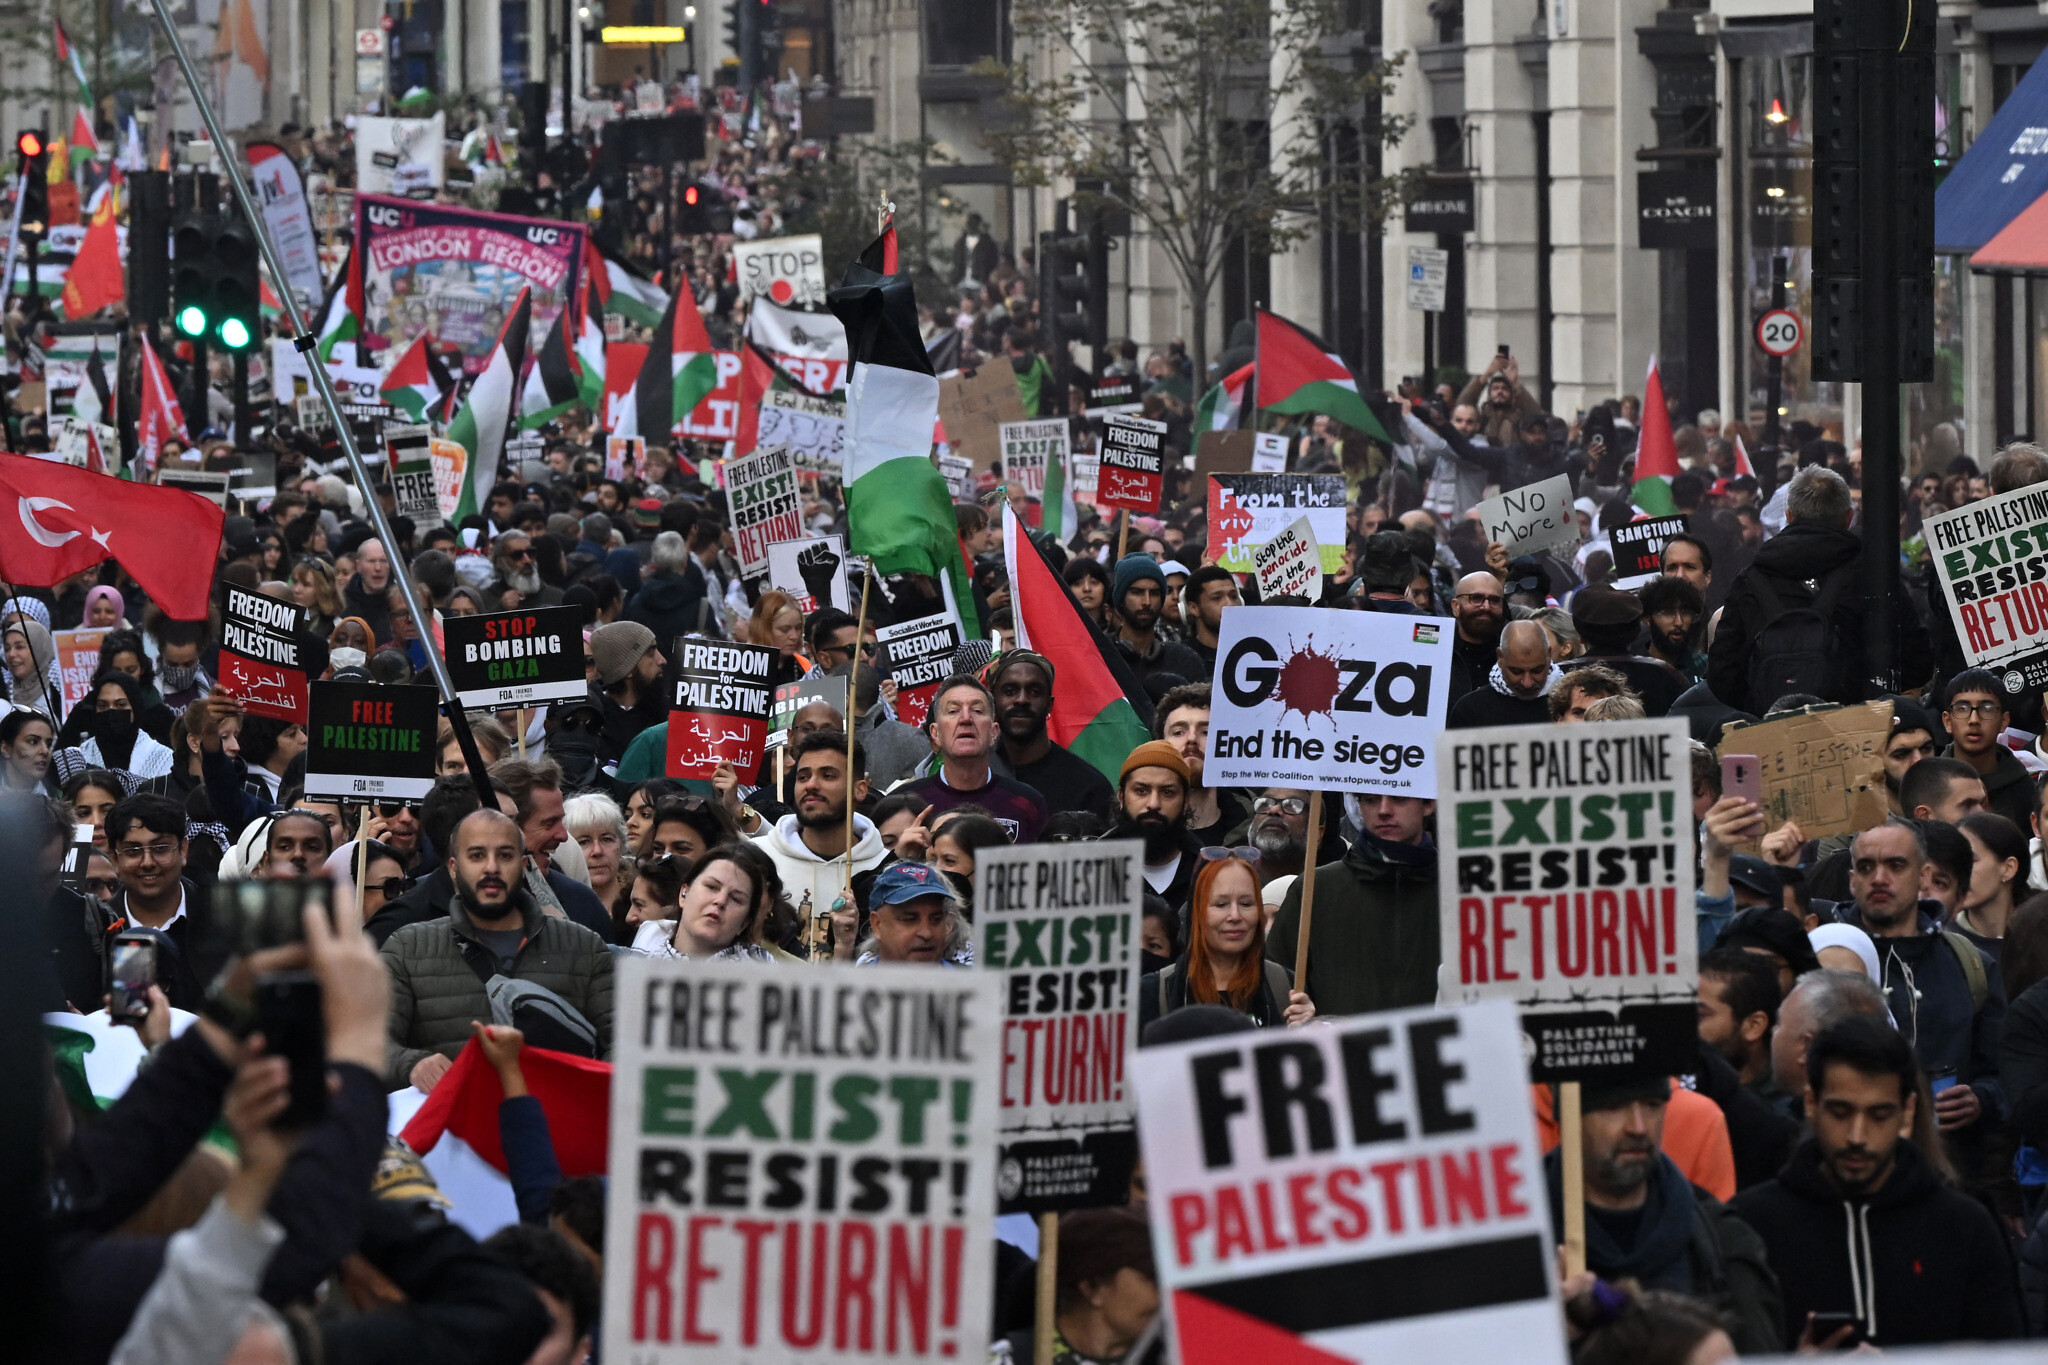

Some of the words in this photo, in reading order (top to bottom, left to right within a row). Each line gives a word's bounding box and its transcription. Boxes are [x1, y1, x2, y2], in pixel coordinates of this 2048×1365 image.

[369, 205, 415, 227] UCU
[1643, 206, 1711, 218] COACH
[527, 226, 575, 246] UCU
[375, 238, 471, 268] LONDON
[480, 243, 561, 286] REGION
[745, 251, 819, 278] STOP
[1766, 323, 1796, 342] 20
[1005, 427, 1022, 439] FREE
[1108, 427, 1159, 449] FREEDOM
[728, 464, 747, 488] FREE
[749, 449, 790, 481] PALESTINE
[1103, 448, 1160, 472] PALESTINE
[394, 473, 436, 500] FREE
[731, 471, 794, 510] EXIST!
[1111, 470, 1148, 487] الحرية
[1105, 487, 1152, 502] لفلسطين
[1220, 488, 1284, 509] From
[1291, 483, 1330, 508] the
[735, 493, 797, 528] RESIST!
[1492, 518, 1554, 543] More
[1616, 519, 1684, 544] SANCTIONS
[1934, 514, 1975, 550] FREE
[1222, 537, 1254, 564] th
[1256, 543, 1276, 568] Stop
[1276, 530, 1296, 550] the
[1261, 540, 1309, 584] genocide
[1280, 566, 1317, 595] ssacre
[1286, 560, 1306, 580] the
[229, 590, 296, 632] FREEDOM
[255, 623, 267, 634] for
[485, 616, 536, 639] STOP
[888, 624, 919, 637] Socialist
[919, 619, 944, 631] Worker
[224, 624, 298, 666] PALESTINE
[465, 635, 561, 662] BOMBING
[888, 629, 952, 661] FREEDOM
[918, 654, 929, 663] for
[488, 658, 540, 681] GAZA
[683, 644, 768, 677] FREEDOM
[891, 656, 954, 688] PALESTIN
[232, 661, 285, 688] الحرية
[719, 671, 734, 684] for
[1222, 636, 1432, 717] Gza
[499, 689, 513, 700] FOA
[676, 681, 769, 715] PALESTINE
[776, 686, 800, 701] OP
[353, 700, 393, 725] FREE
[323, 725, 421, 752] PALESTINE
[690, 718, 750, 744] الحرية
[681, 745, 753, 768] لفلسطين
[1214, 729, 1263, 758] End
[1272, 730, 1324, 761] the
[1333, 735, 1425, 775] siege
[1454, 742, 1519, 793] FREE
[1530, 734, 1673, 789] PALESTINE
[353, 780, 366, 791] FOA
[1221, 770, 1238, 780] Stop
[1240, 769, 1251, 778] the
[1254, 770, 1270, 779] War
[1272, 771, 1313, 781] Coalition
[1319, 775, 1412, 788] www.stopwar.org.uk
[1456, 790, 1675, 849] EXIST!
[1457, 844, 1676, 894] RESIST!
[985, 862, 1028, 913] FREE
[1035, 856, 1132, 908] PALESTINE
[983, 914, 1130, 969] EXIST!
[1459, 887, 1677, 985] RETURN!
[1009, 969, 1128, 1015] ESIST!
[643, 978, 738, 1053] FREE
[758, 983, 975, 1063] PALESTINE
[1542, 1025, 1636, 1040] PALESTINE
[1001, 1012, 1126, 1107] ETURN!
[1542, 1038, 1647, 1054] SOLIDARITY
[1542, 1052, 1634, 1068] CAMPAIGN
[640, 1064, 973, 1148] EXIST!
[1191, 1015, 1475, 1170] FREE
[638, 1147, 971, 1217] RESIST!
[1169, 1144, 1530, 1267] PALESTINE
[633, 1213, 965, 1357] RETURN!
